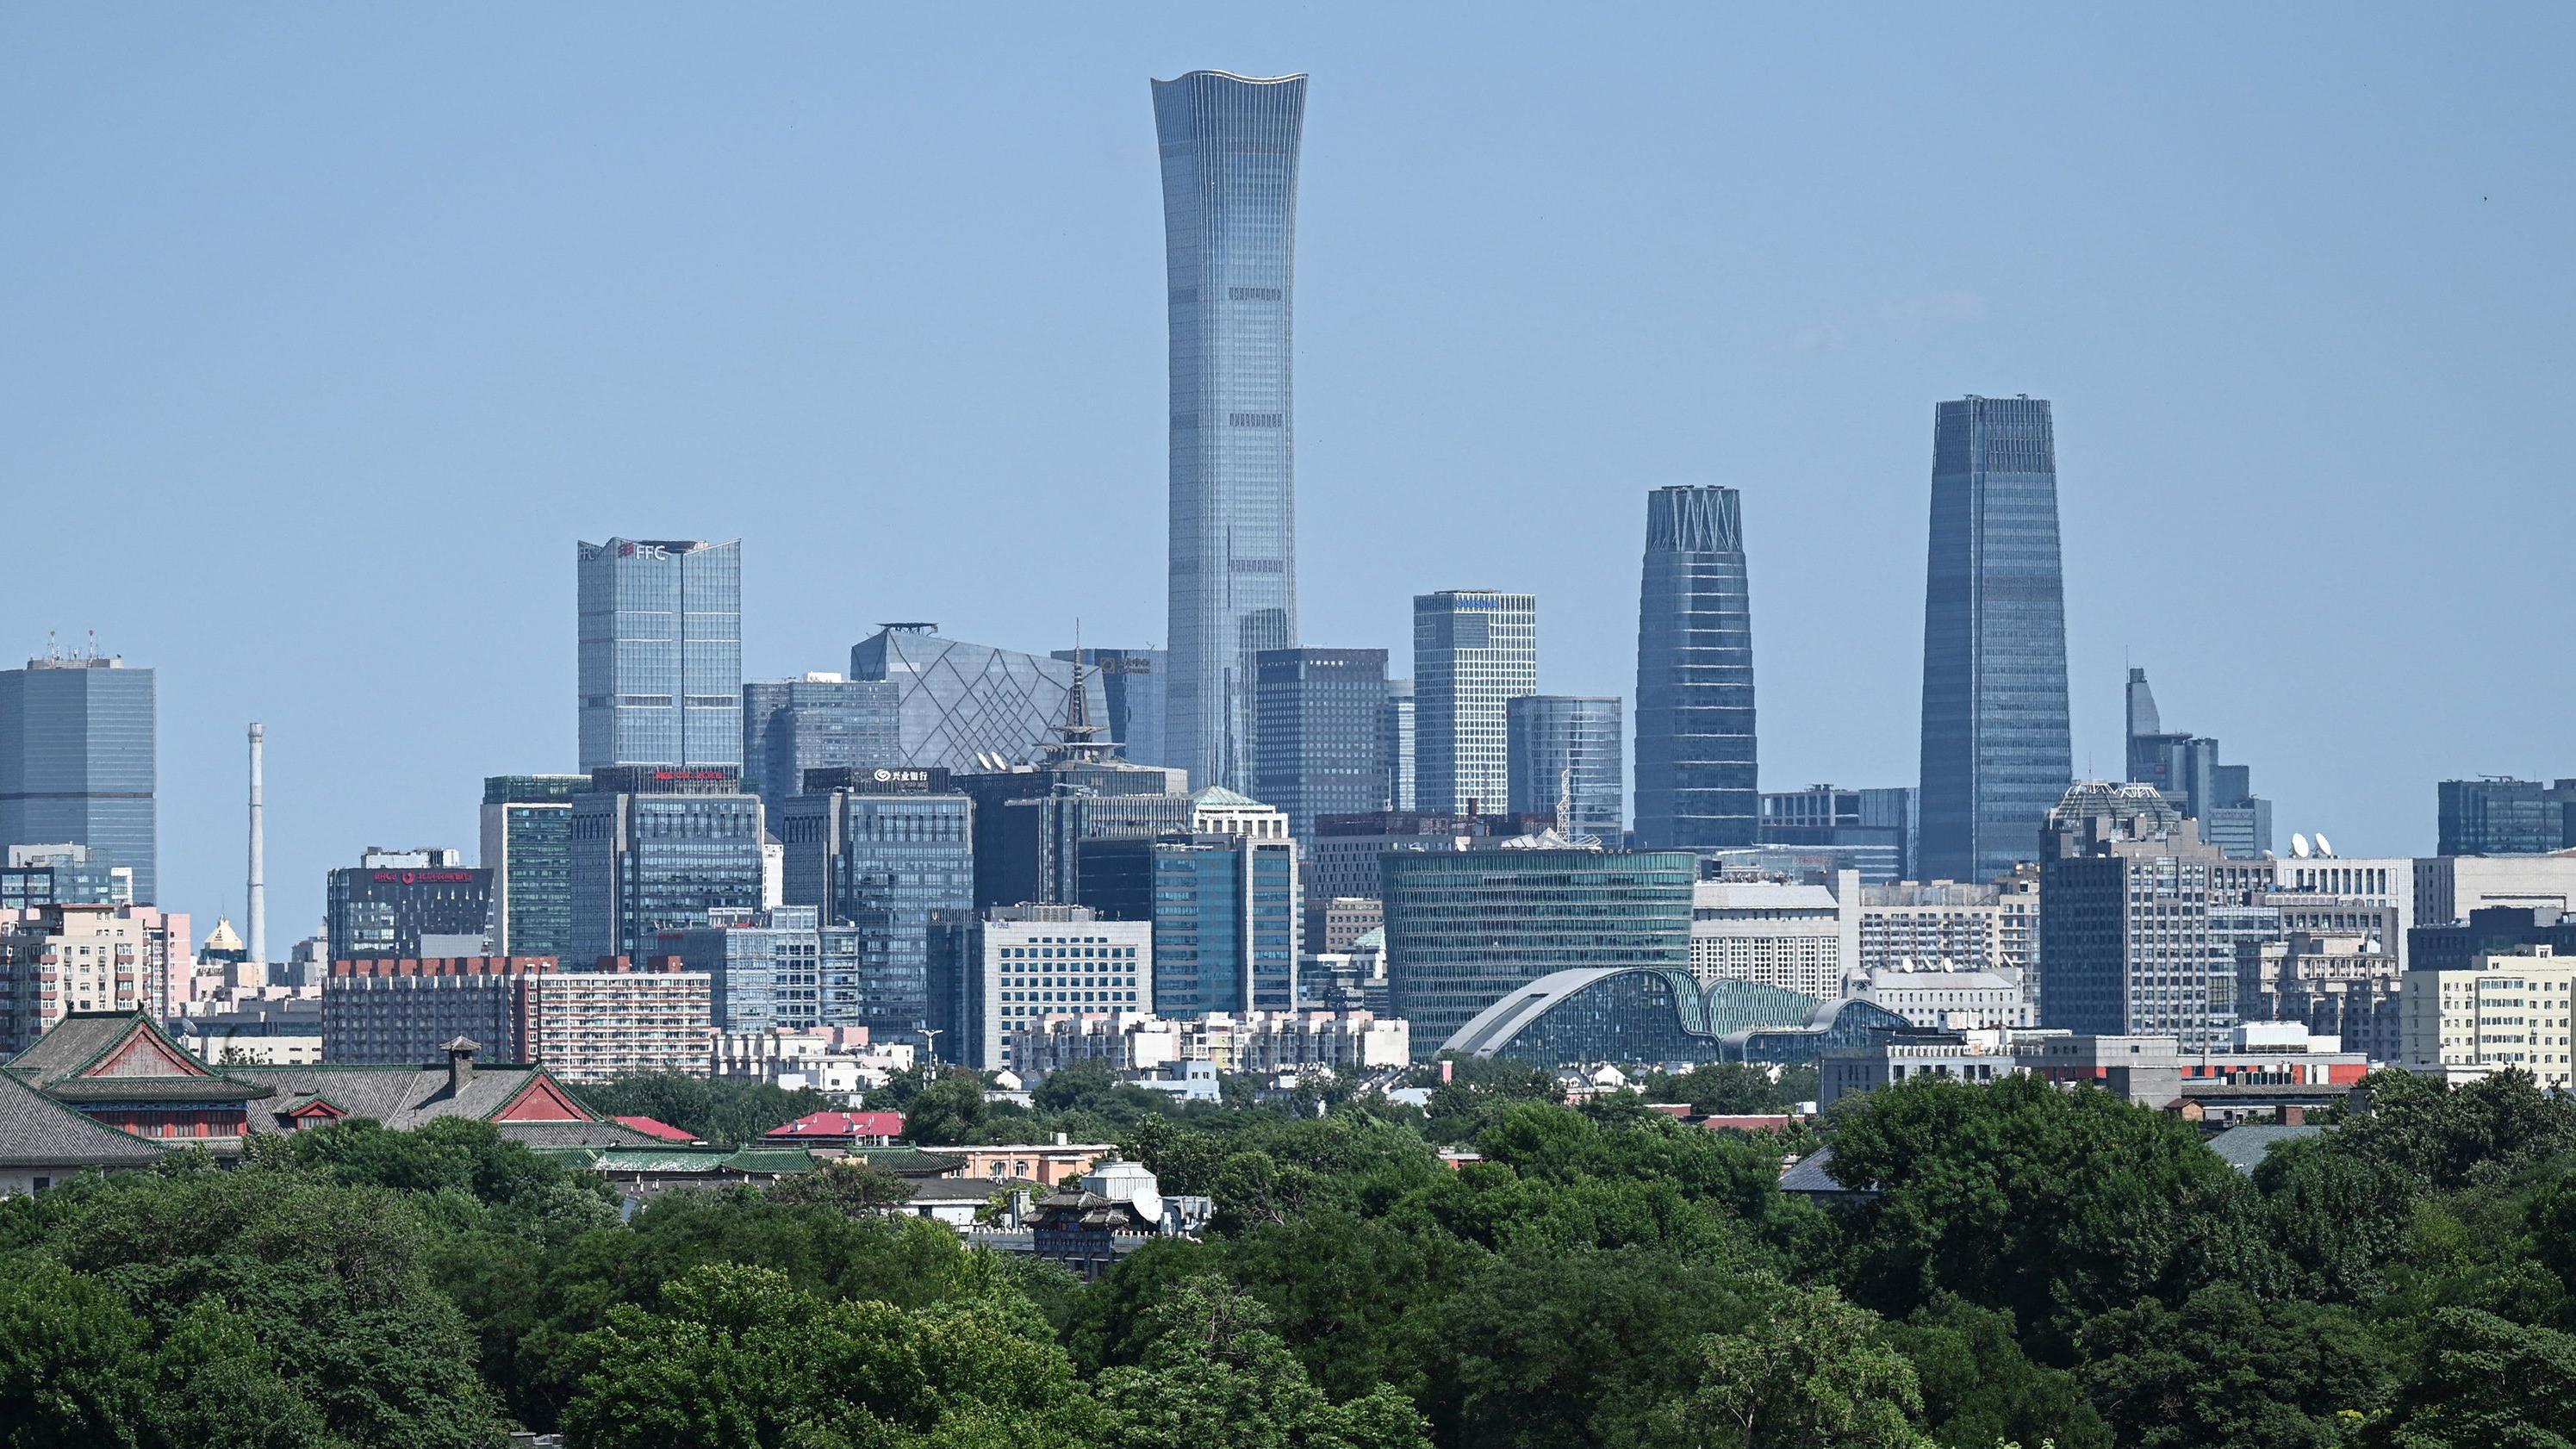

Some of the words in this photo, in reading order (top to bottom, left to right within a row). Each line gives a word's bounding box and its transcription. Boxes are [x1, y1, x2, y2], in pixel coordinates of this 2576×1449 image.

[636, 545, 666, 560] FFC
[893, 771, 927, 780] 兴业银行
